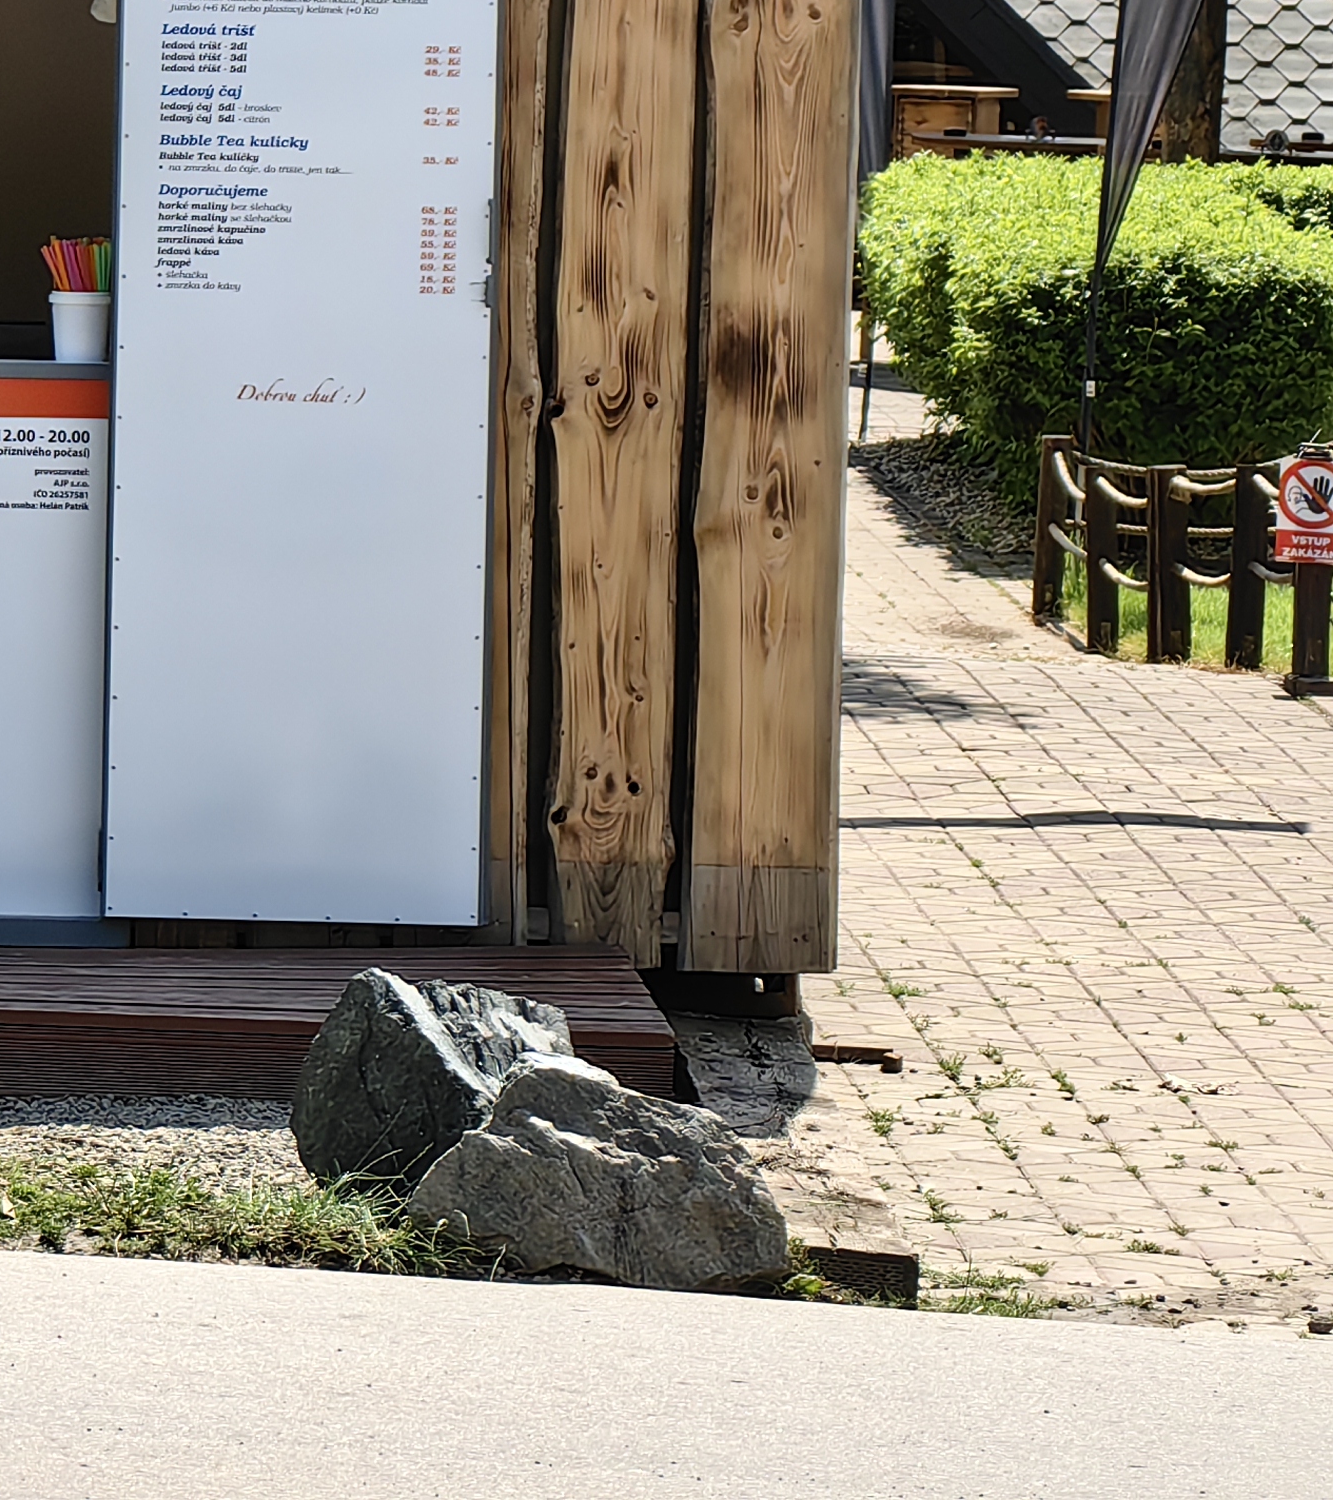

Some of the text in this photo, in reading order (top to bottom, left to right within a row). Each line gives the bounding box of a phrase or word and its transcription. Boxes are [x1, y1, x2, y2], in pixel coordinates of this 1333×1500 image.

[161, 23, 217, 35] Ledová
[161, 41, 195, 49] ledová
[161, 52, 195, 60] ledová
[161, 63, 195, 71] ledová
[160, 84, 243, 100] Ledový čaj
[160, 102, 193, 112] ledový
[196, 102, 213, 112] čaj
[160, 113, 193, 123] ledový
[196, 114, 212, 124] čaj
[159, 134, 212, 146] Bubble
[217, 135, 245, 147] Tea
[159, 152, 194, 160] Bubble
[197, 152, 216, 160] Tea
[159, 184, 268, 199] Doporučujeme
[158, 200, 189, 209] horké
[191, 202, 228, 212] maliny
[158, 212, 189, 221] horké
[191, 213, 228, 224] maliny
[157, 224, 214, 232] zmrzlinové
[157, 235, 244, 244] zmrzlinová káva
[157, 246, 220, 255] ledová káva
[154, 257, 191, 268] frappé
[202, 282, 216, 290] do
[237, 378, 296, 402] Dobrou
[48, 430, 90, 444] 20.00
[54, 447, 90, 459] počasí)
[53, 479, 69, 487] AJP
[1291, 534, 1331, 546] VSTUP
